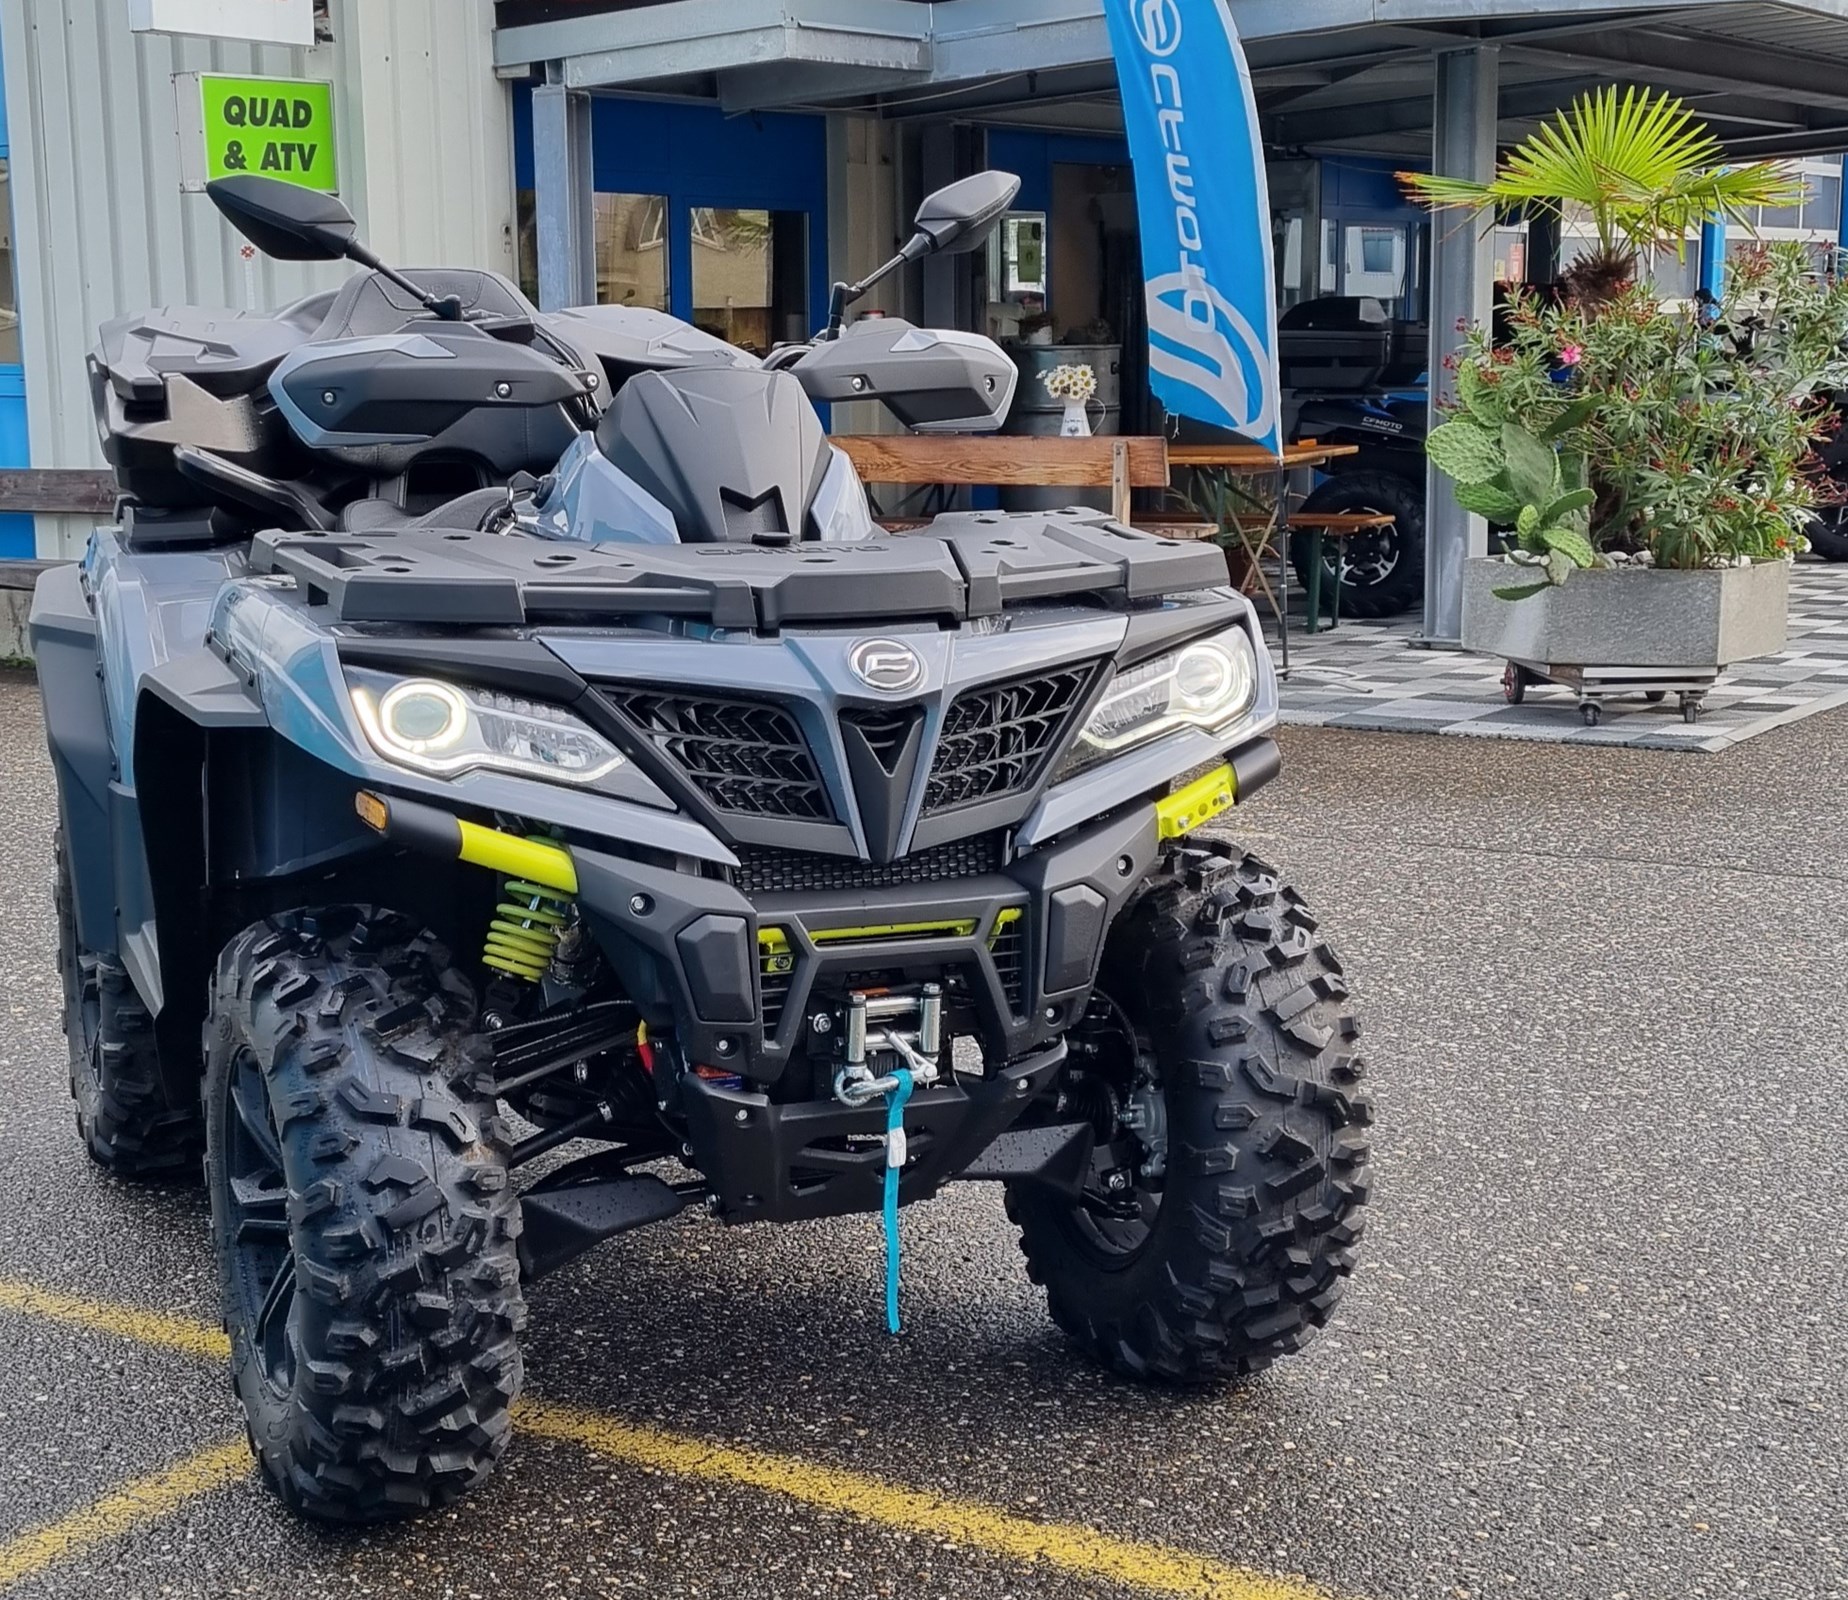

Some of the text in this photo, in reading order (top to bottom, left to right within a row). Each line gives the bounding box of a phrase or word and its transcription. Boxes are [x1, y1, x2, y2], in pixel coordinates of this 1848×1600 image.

[223, 96, 312, 128] QUAD
[223, 140, 318, 172] & ATV
[1362, 416, 1404, 430] CFMOTO
